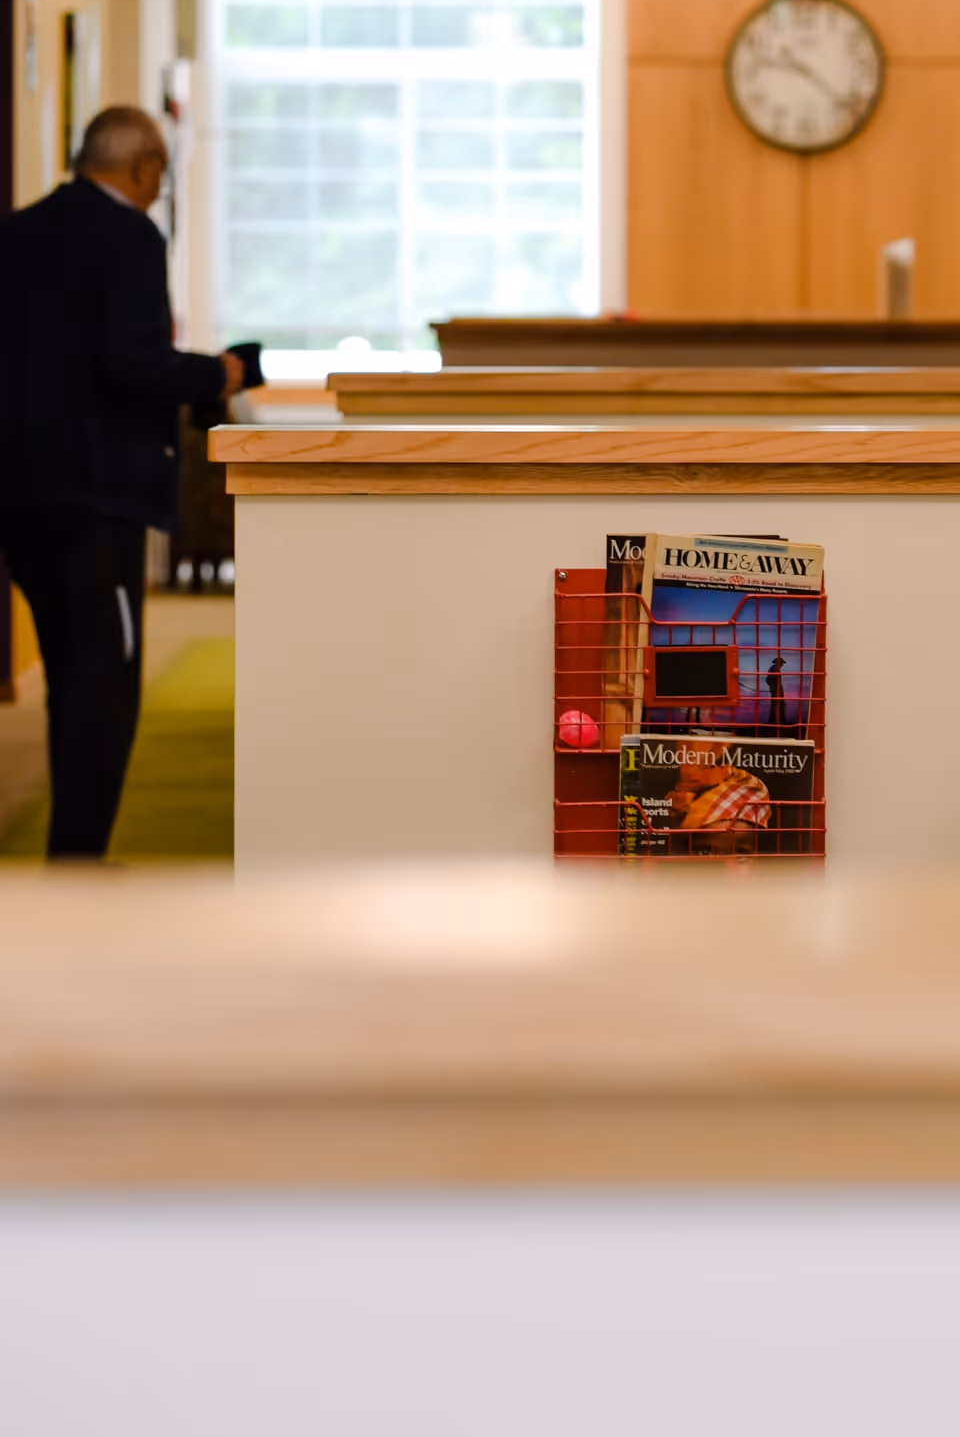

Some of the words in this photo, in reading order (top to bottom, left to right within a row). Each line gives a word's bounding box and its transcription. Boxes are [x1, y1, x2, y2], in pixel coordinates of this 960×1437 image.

[642, 743, 716, 765] Modern
[722, 746, 808, 772] Maturity
[641, 797, 672, 807] Island
